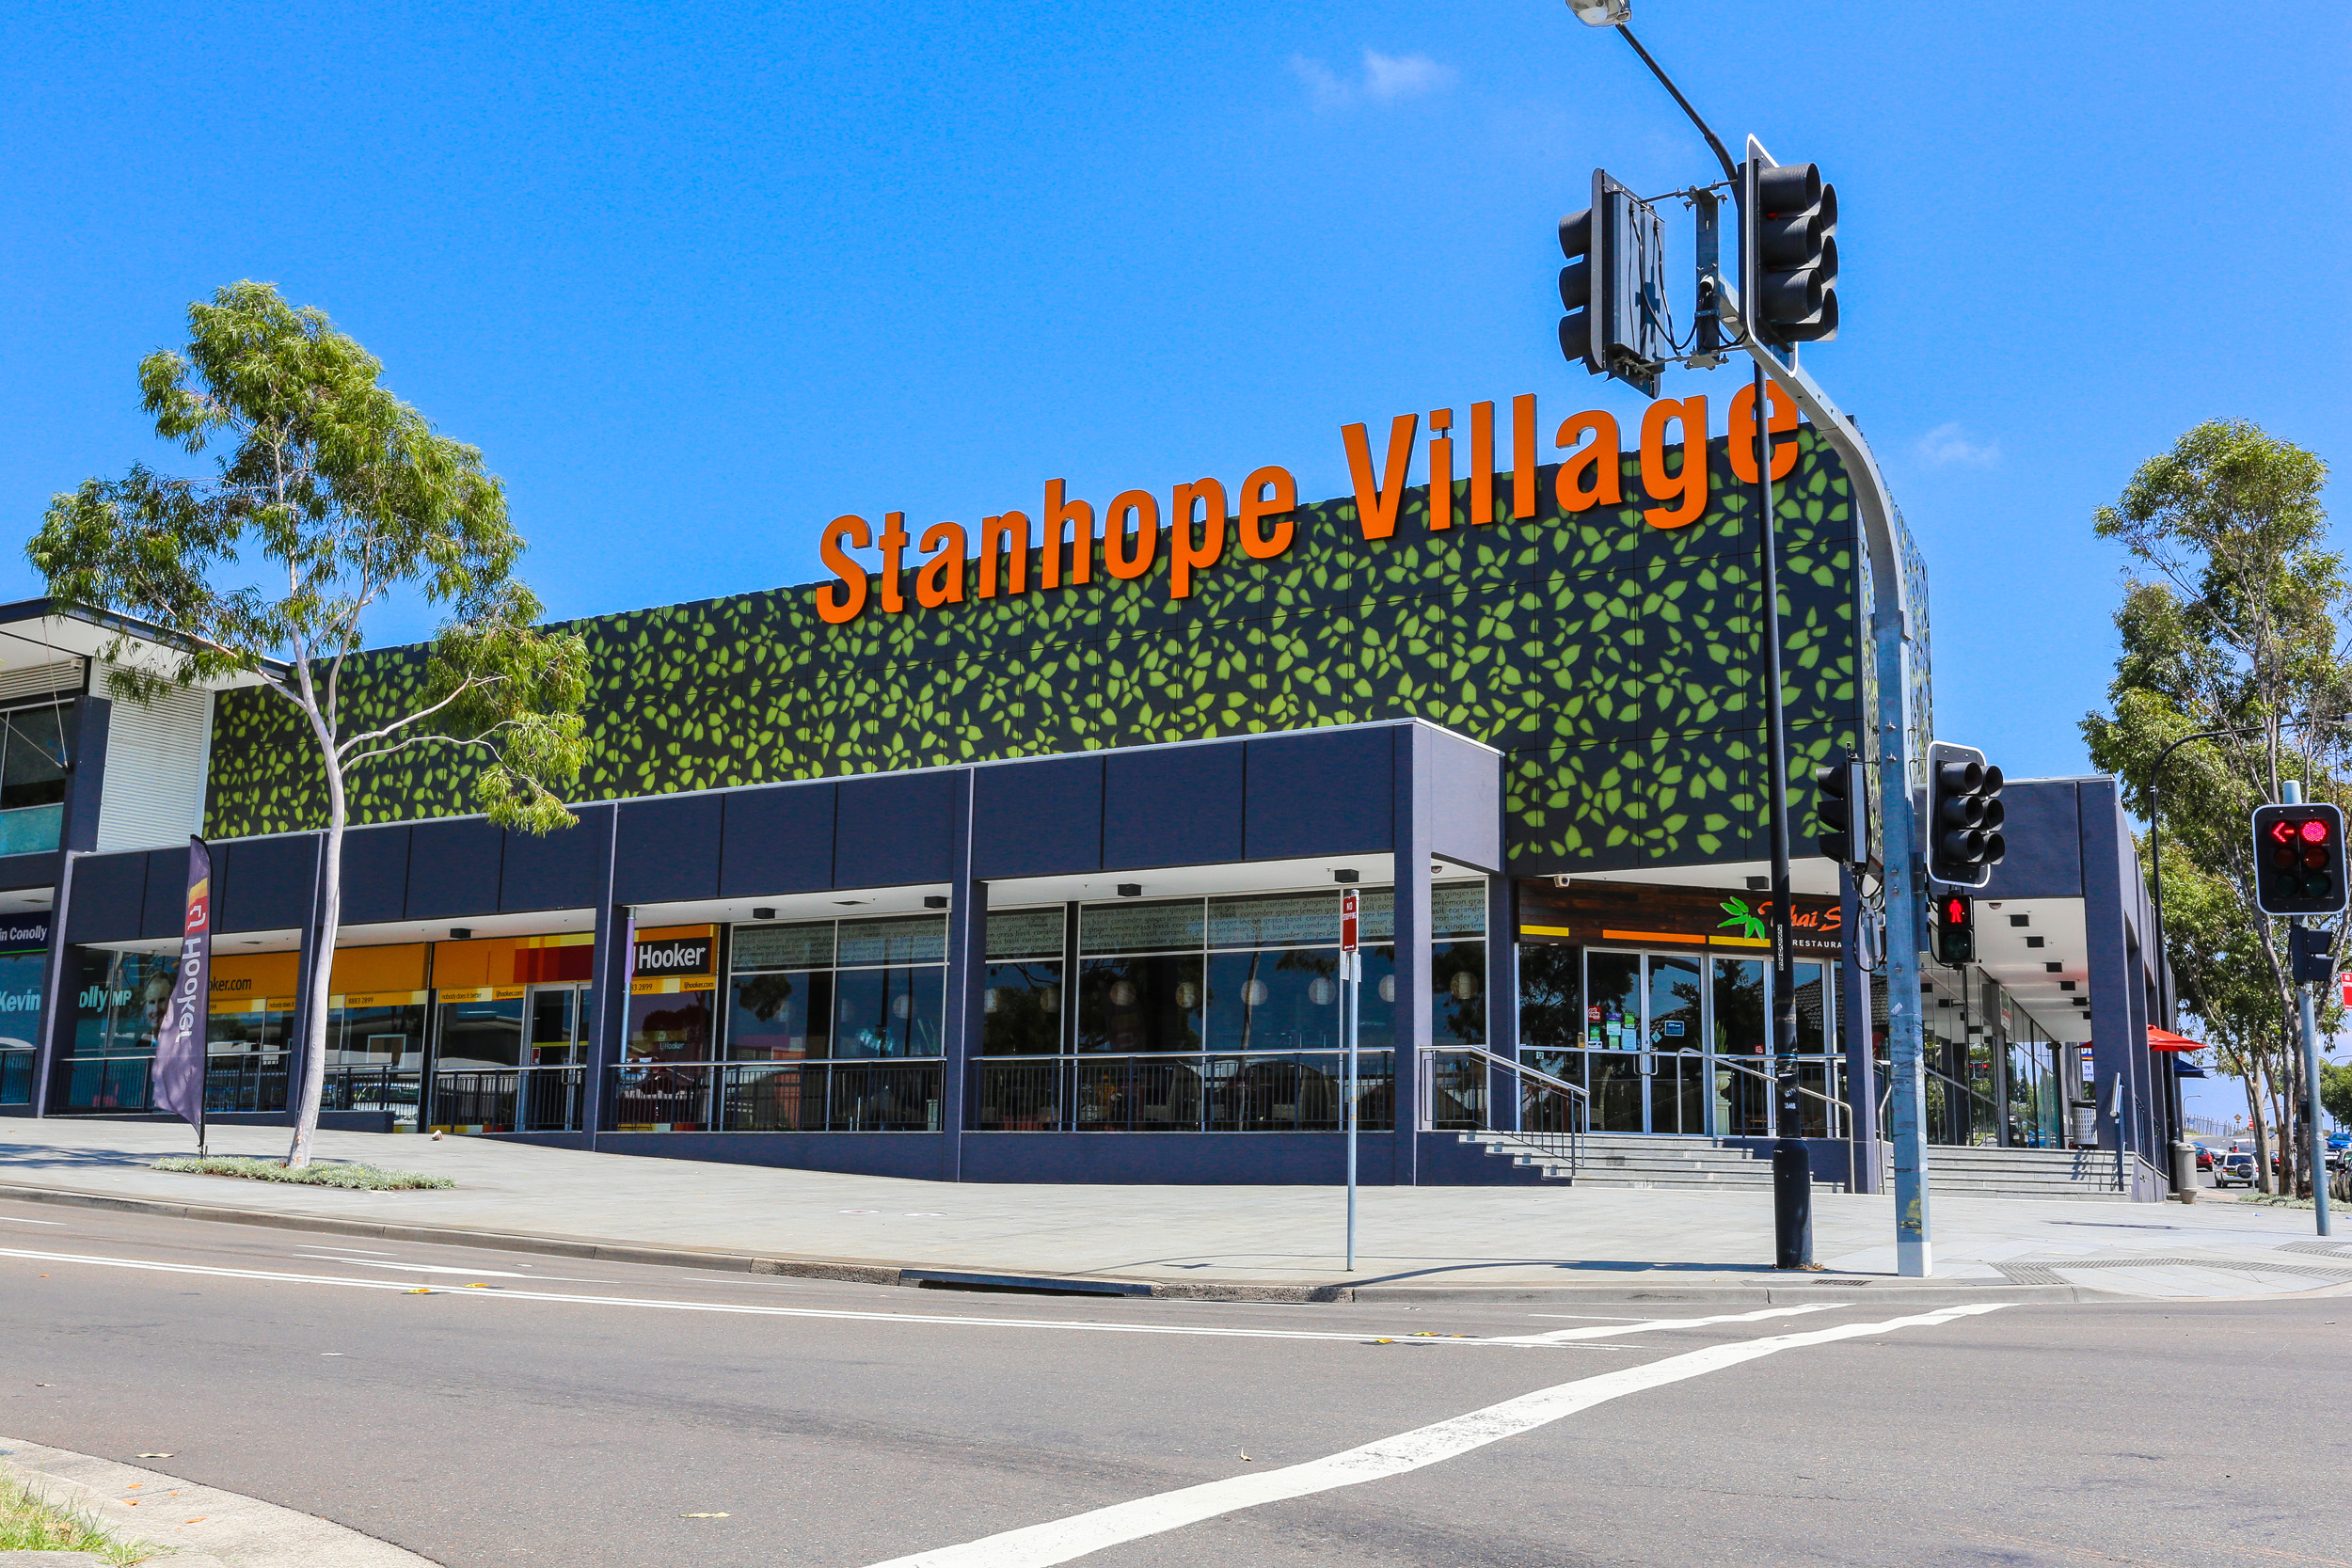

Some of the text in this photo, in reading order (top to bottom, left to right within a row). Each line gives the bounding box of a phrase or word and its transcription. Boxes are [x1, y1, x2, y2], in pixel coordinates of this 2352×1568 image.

[815, 376, 1801, 625] Stanhope Village
[1346, 902, 1353, 911] NO
[1343, 911, 1357, 921] STOPPING
[9, 925, 48, 942] Conolly
[1792, 939, 1842, 949] RESTAURA
[638, 942, 707, 970] Hooker
[111, 990, 132, 1006] MP
[175, 938, 201, 1043] Hooker
[0, 989, 40, 1012] Kevin
